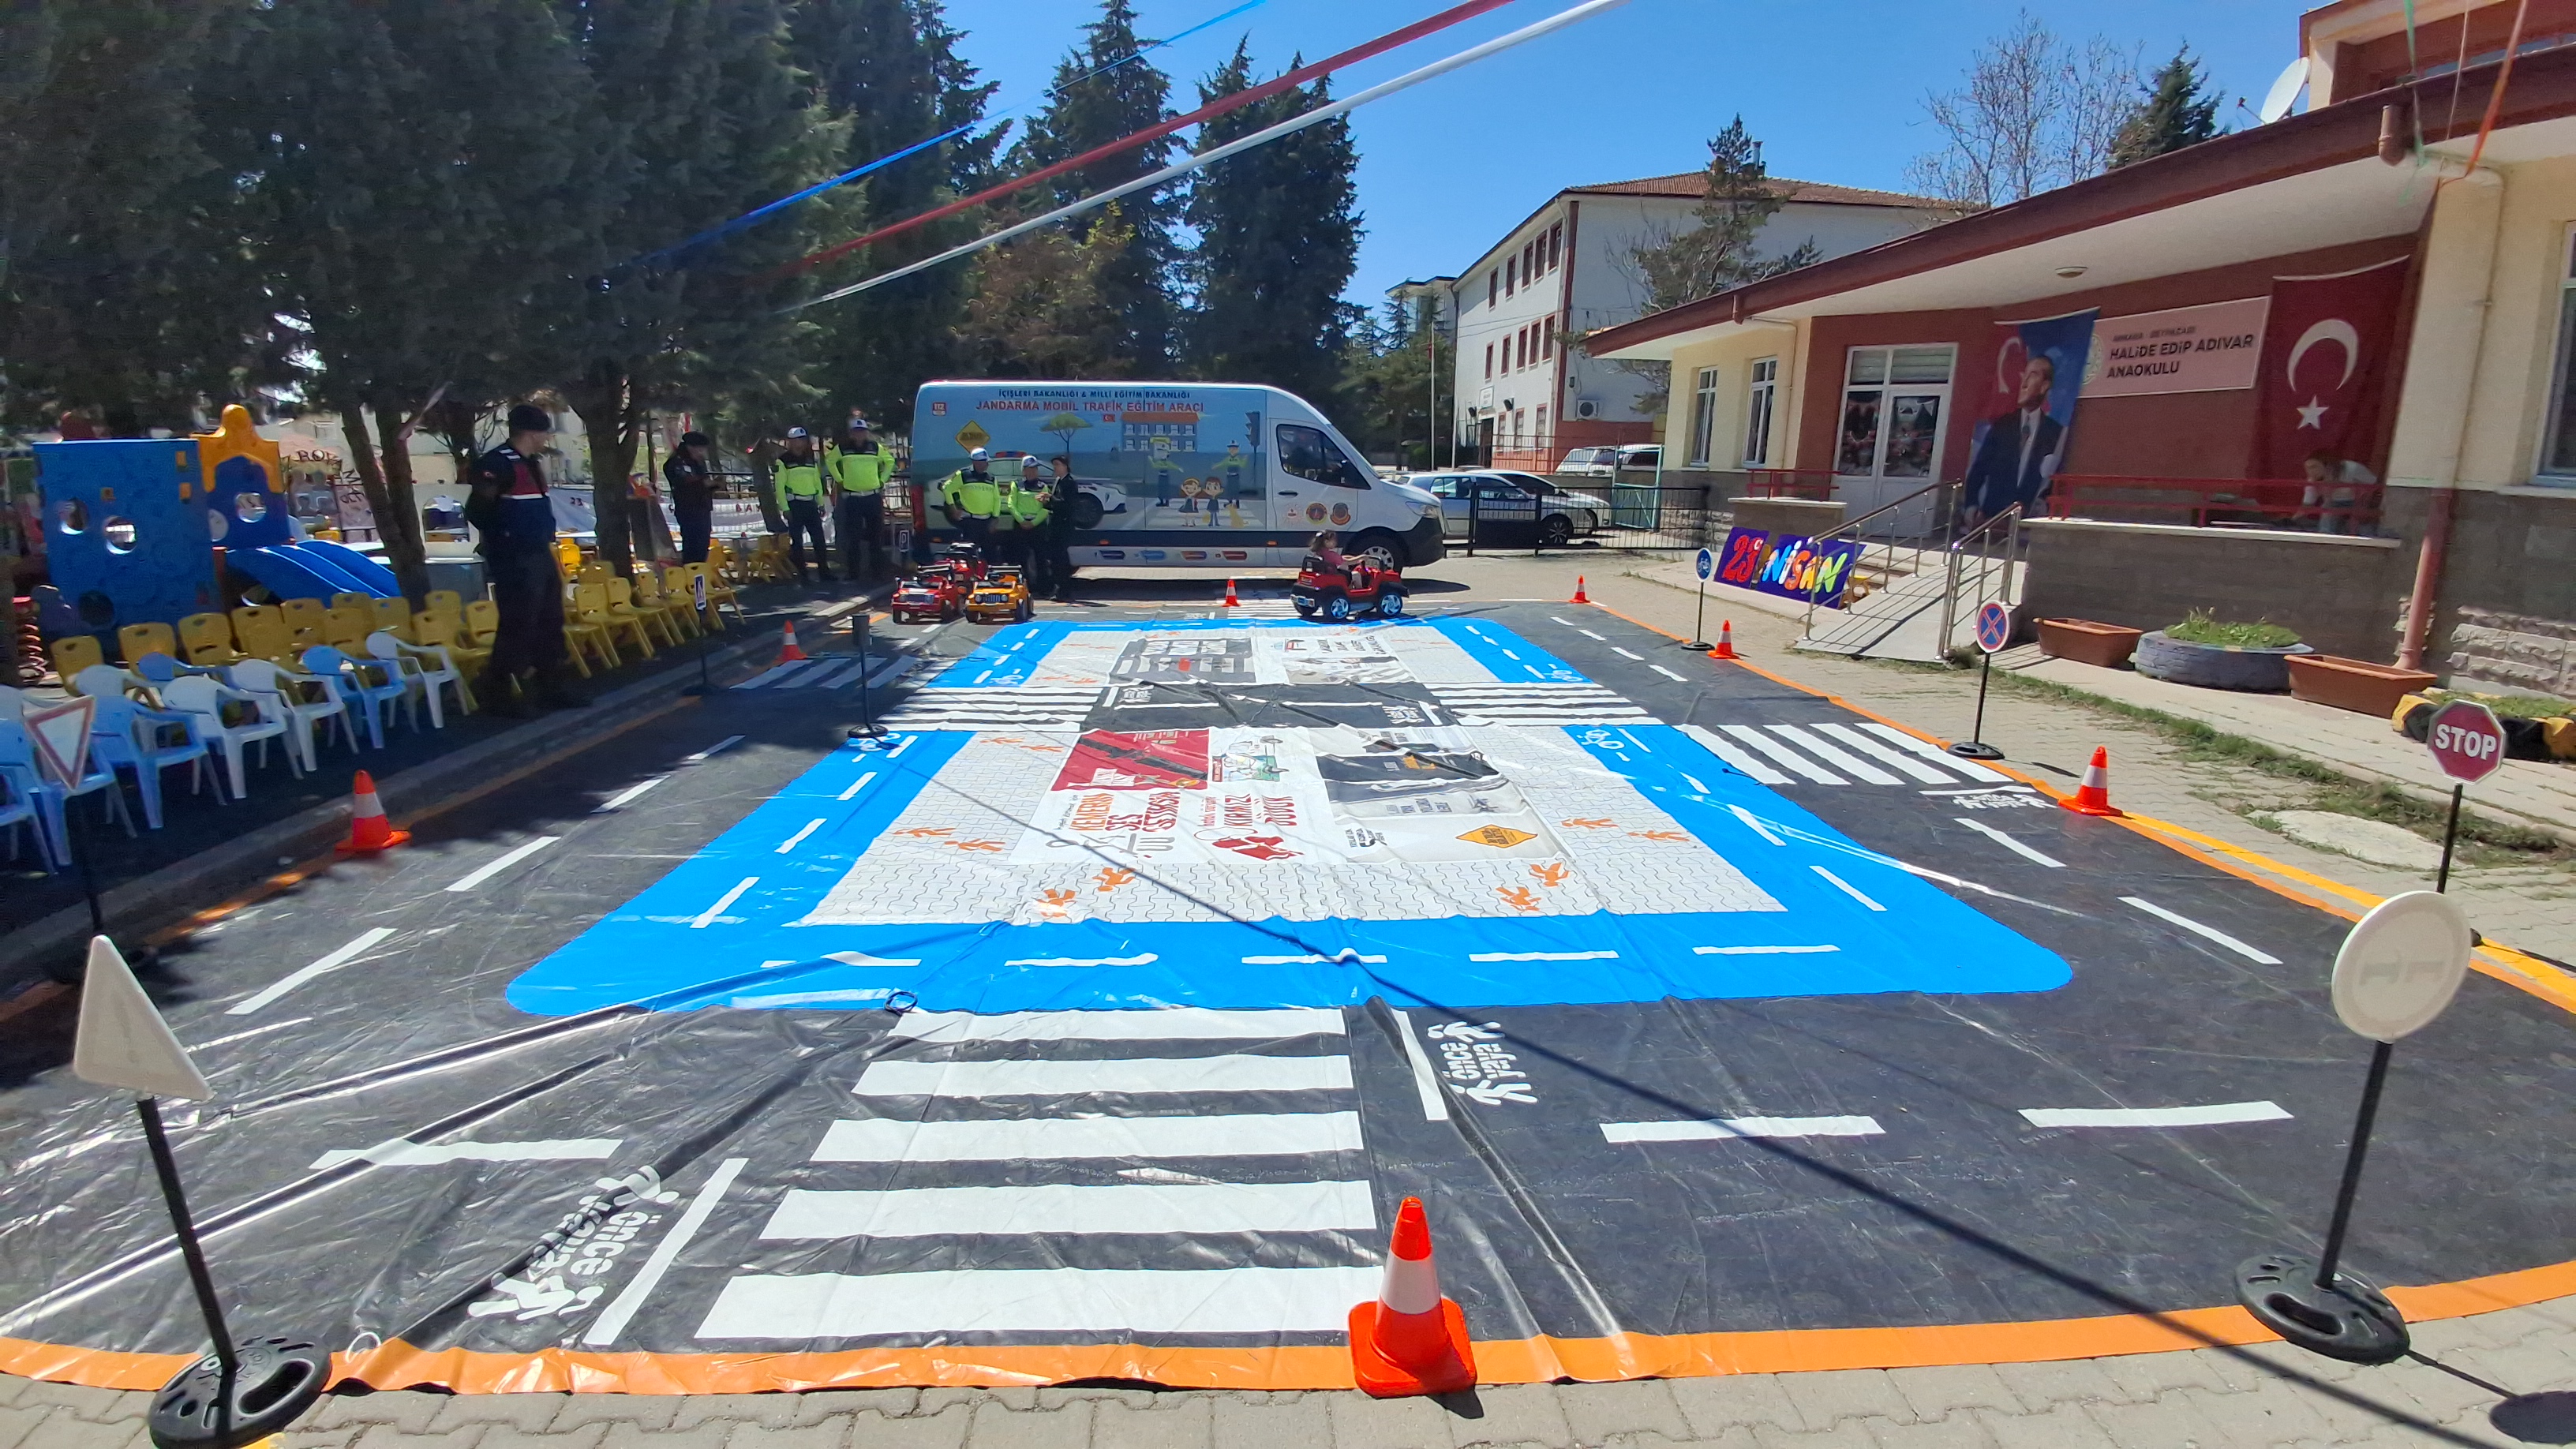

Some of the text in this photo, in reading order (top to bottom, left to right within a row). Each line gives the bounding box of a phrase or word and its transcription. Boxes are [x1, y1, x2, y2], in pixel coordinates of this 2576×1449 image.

[2195, 335, 2254, 353] ADIVAR
[2106, 361, 2181, 379] ANAOKULU
[975, 400, 1039, 411] JANDARMA
[2435, 724, 2497, 761] STOP
